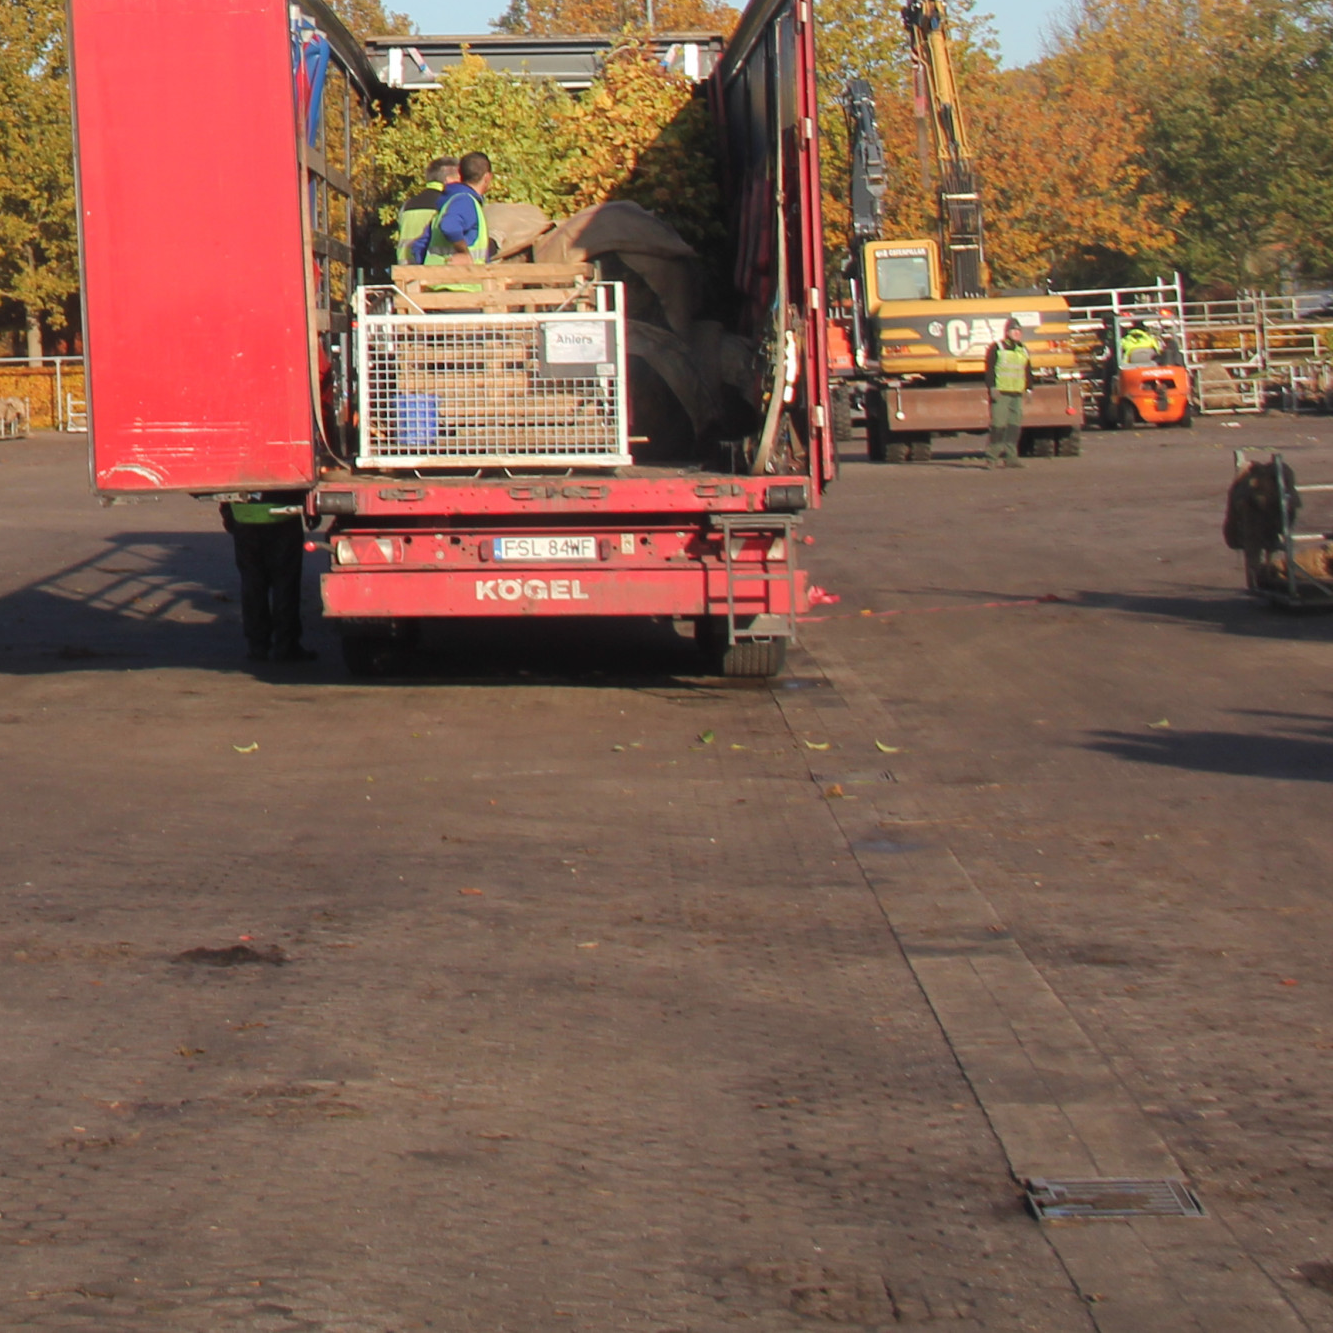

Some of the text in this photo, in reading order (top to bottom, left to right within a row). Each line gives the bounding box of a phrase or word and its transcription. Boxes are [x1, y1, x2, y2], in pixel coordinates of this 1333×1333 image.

[556, 333, 593, 344] Ahlers
[504, 539, 542, 557] FSL
[475, 578, 589, 601] KÖGEL
